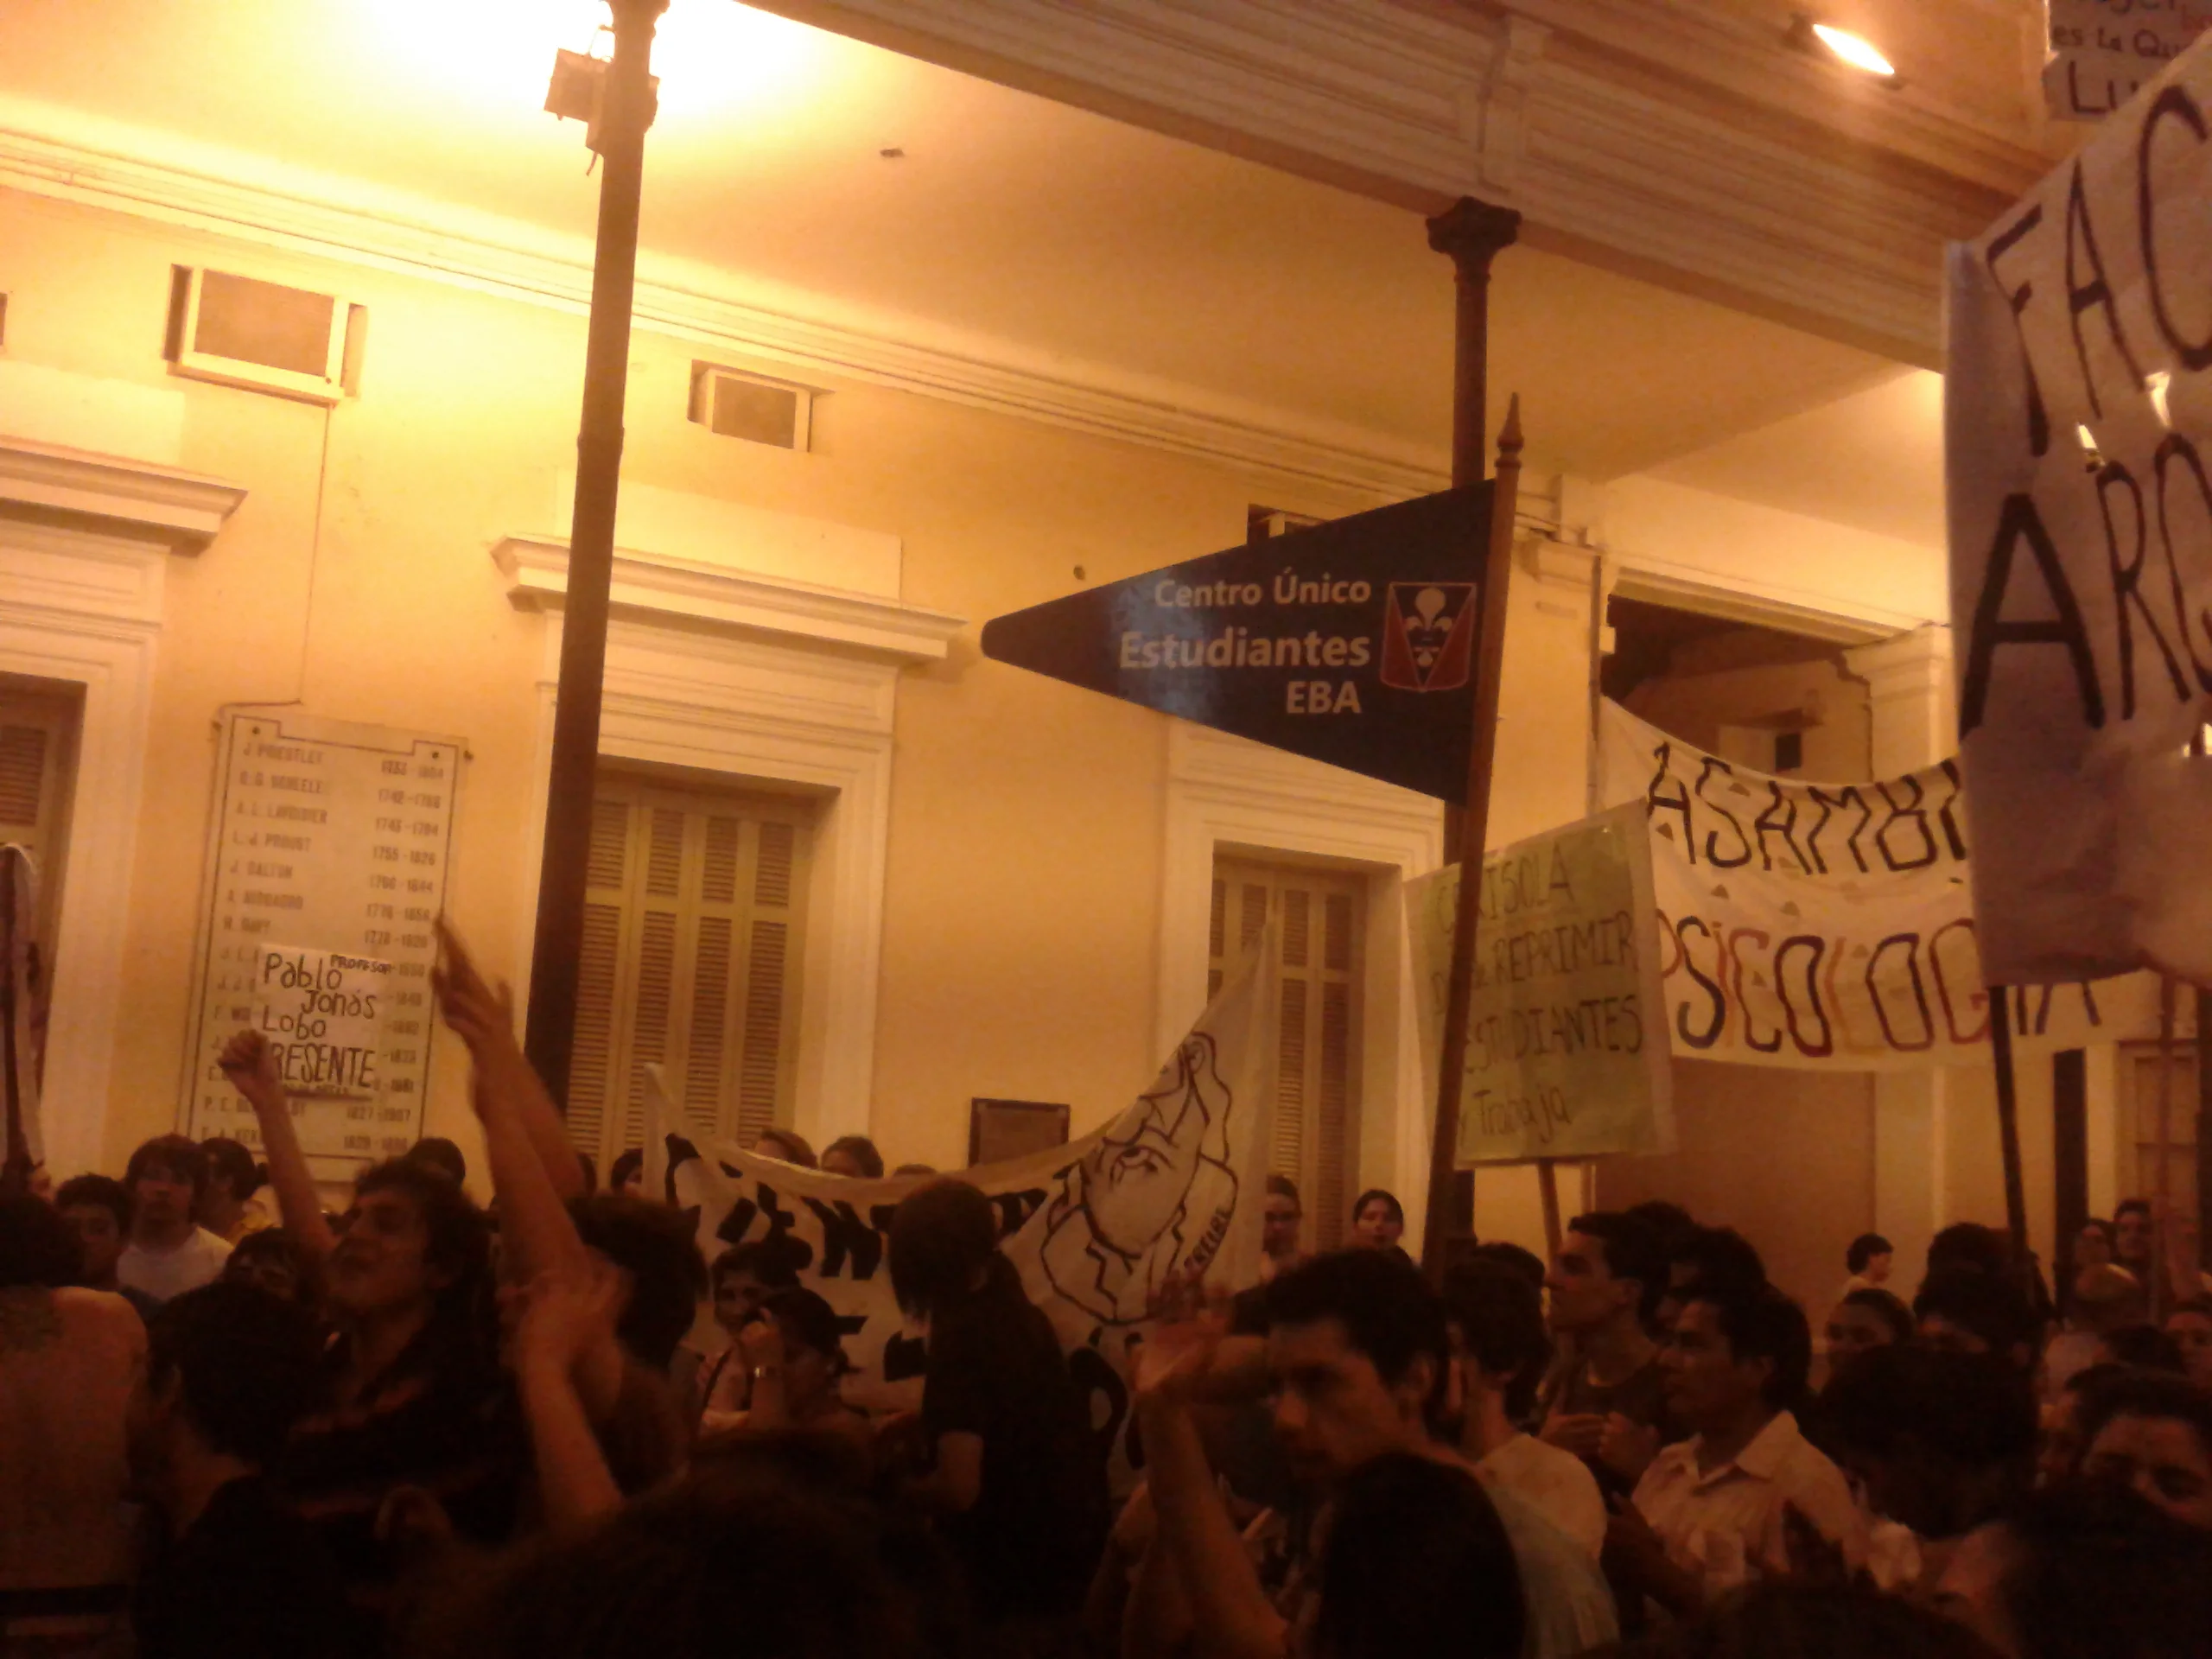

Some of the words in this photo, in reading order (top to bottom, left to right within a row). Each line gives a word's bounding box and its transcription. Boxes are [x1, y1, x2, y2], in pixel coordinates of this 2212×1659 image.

[1154, 579, 1262, 607] Centro
[1273, 567, 1372, 605] Único
[1119, 626, 1371, 669] Estudiantes
[1286, 680, 1362, 714] EBA
[1494, 911, 1639, 986] REPRIMIR
[264, 952, 342, 990] Pablo
[262, 1005, 327, 1039] Lobo
[271, 1042, 376, 1088] RESENTE
